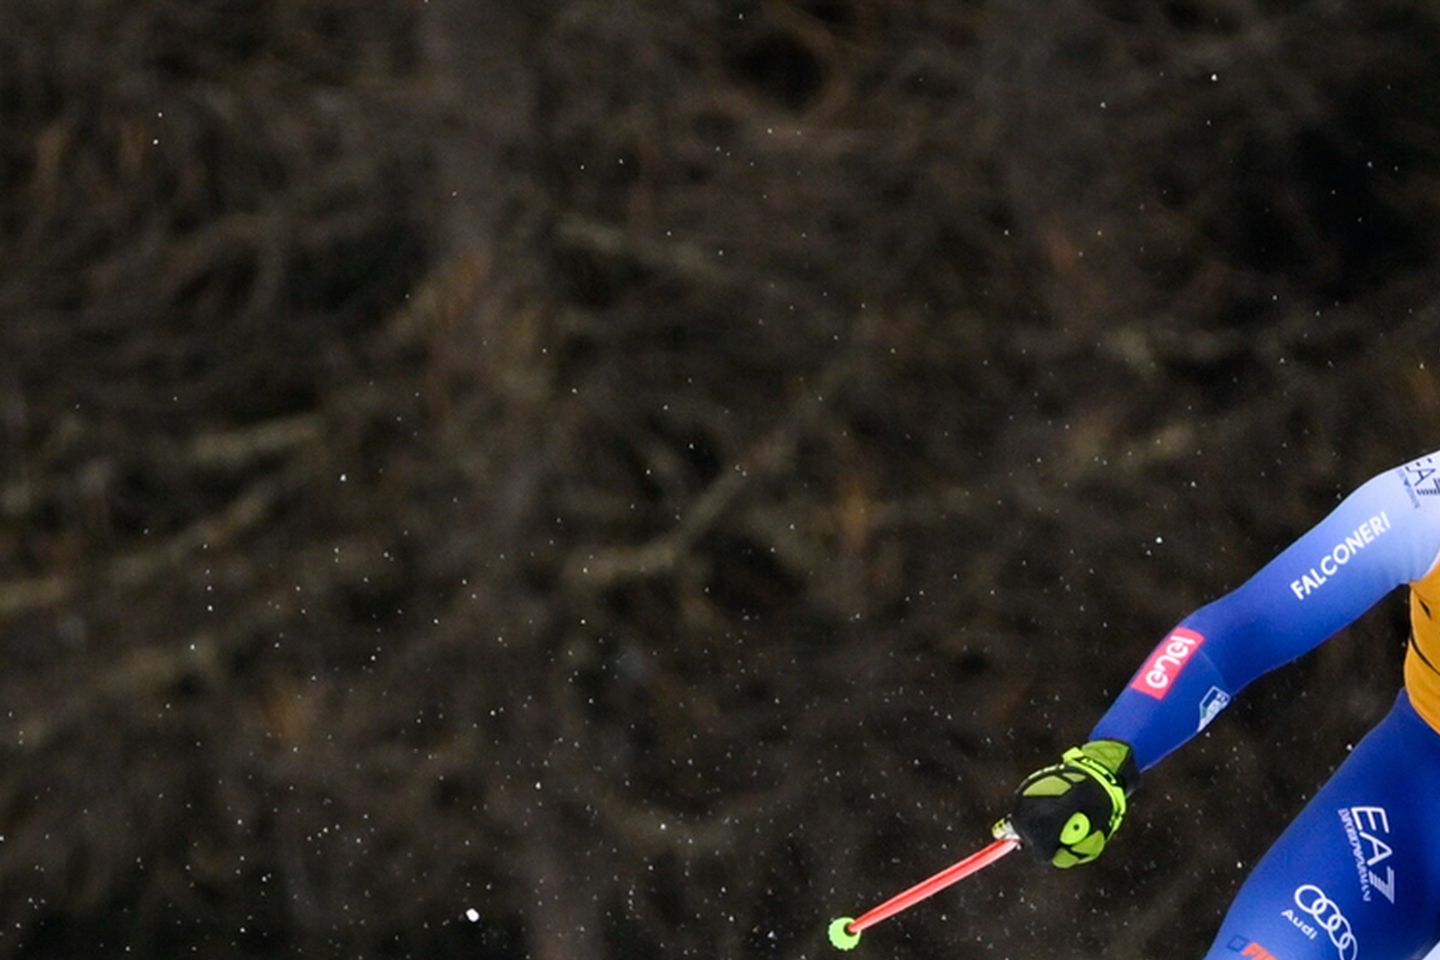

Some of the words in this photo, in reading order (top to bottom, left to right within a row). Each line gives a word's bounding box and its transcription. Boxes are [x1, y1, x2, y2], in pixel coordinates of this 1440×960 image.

[1290, 510, 1391, 600] FALCONERI
[1145, 635, 1196, 689] enel
[1351, 806, 1395, 904] EA7
[1281, 908, 1318, 940] Audi
